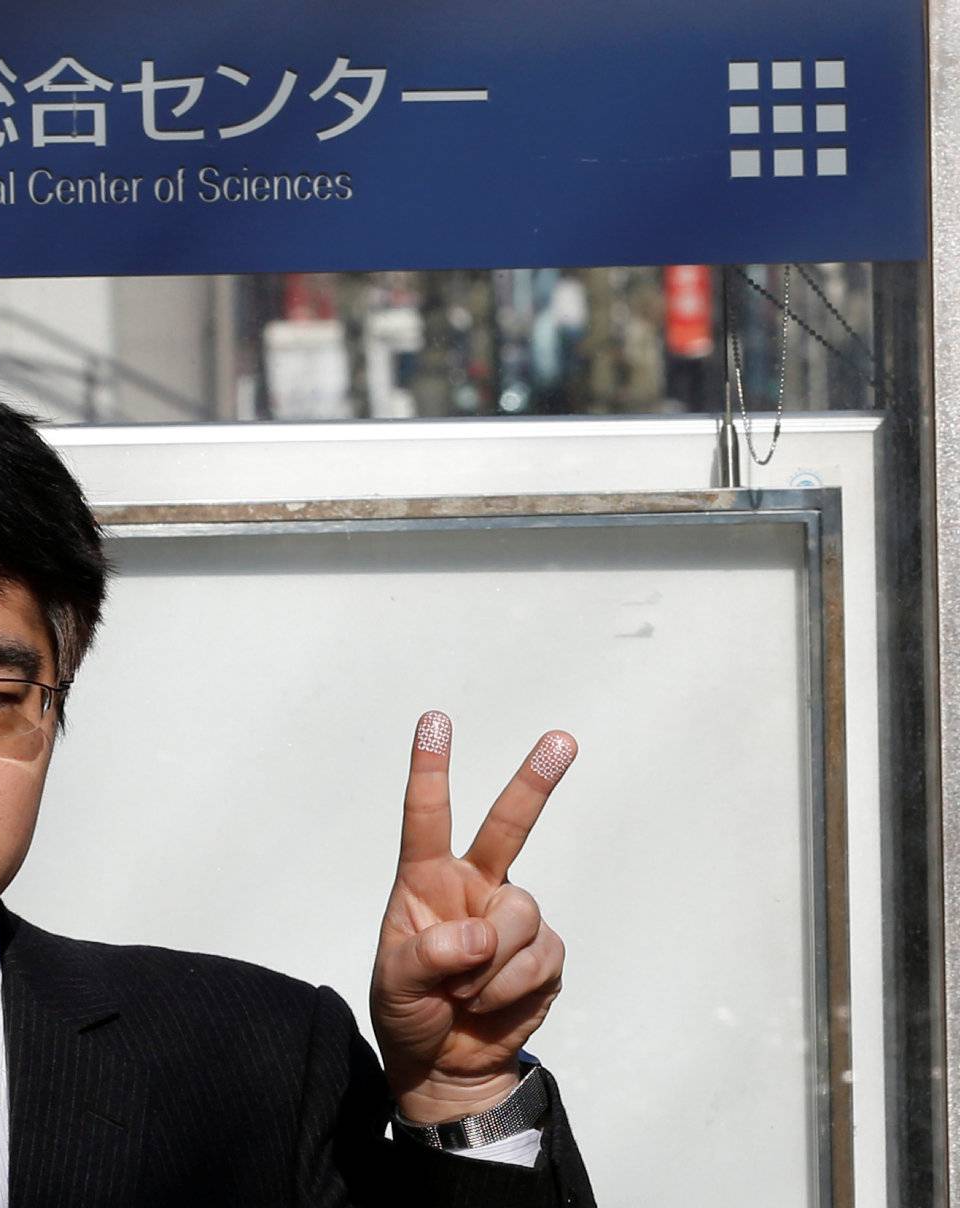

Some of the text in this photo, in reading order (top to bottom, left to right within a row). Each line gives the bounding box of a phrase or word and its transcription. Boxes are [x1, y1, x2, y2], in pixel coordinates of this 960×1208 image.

[27, 168, 144, 205] Center
[153, 168, 185, 203] of
[198, 166, 354, 202] Sciences
